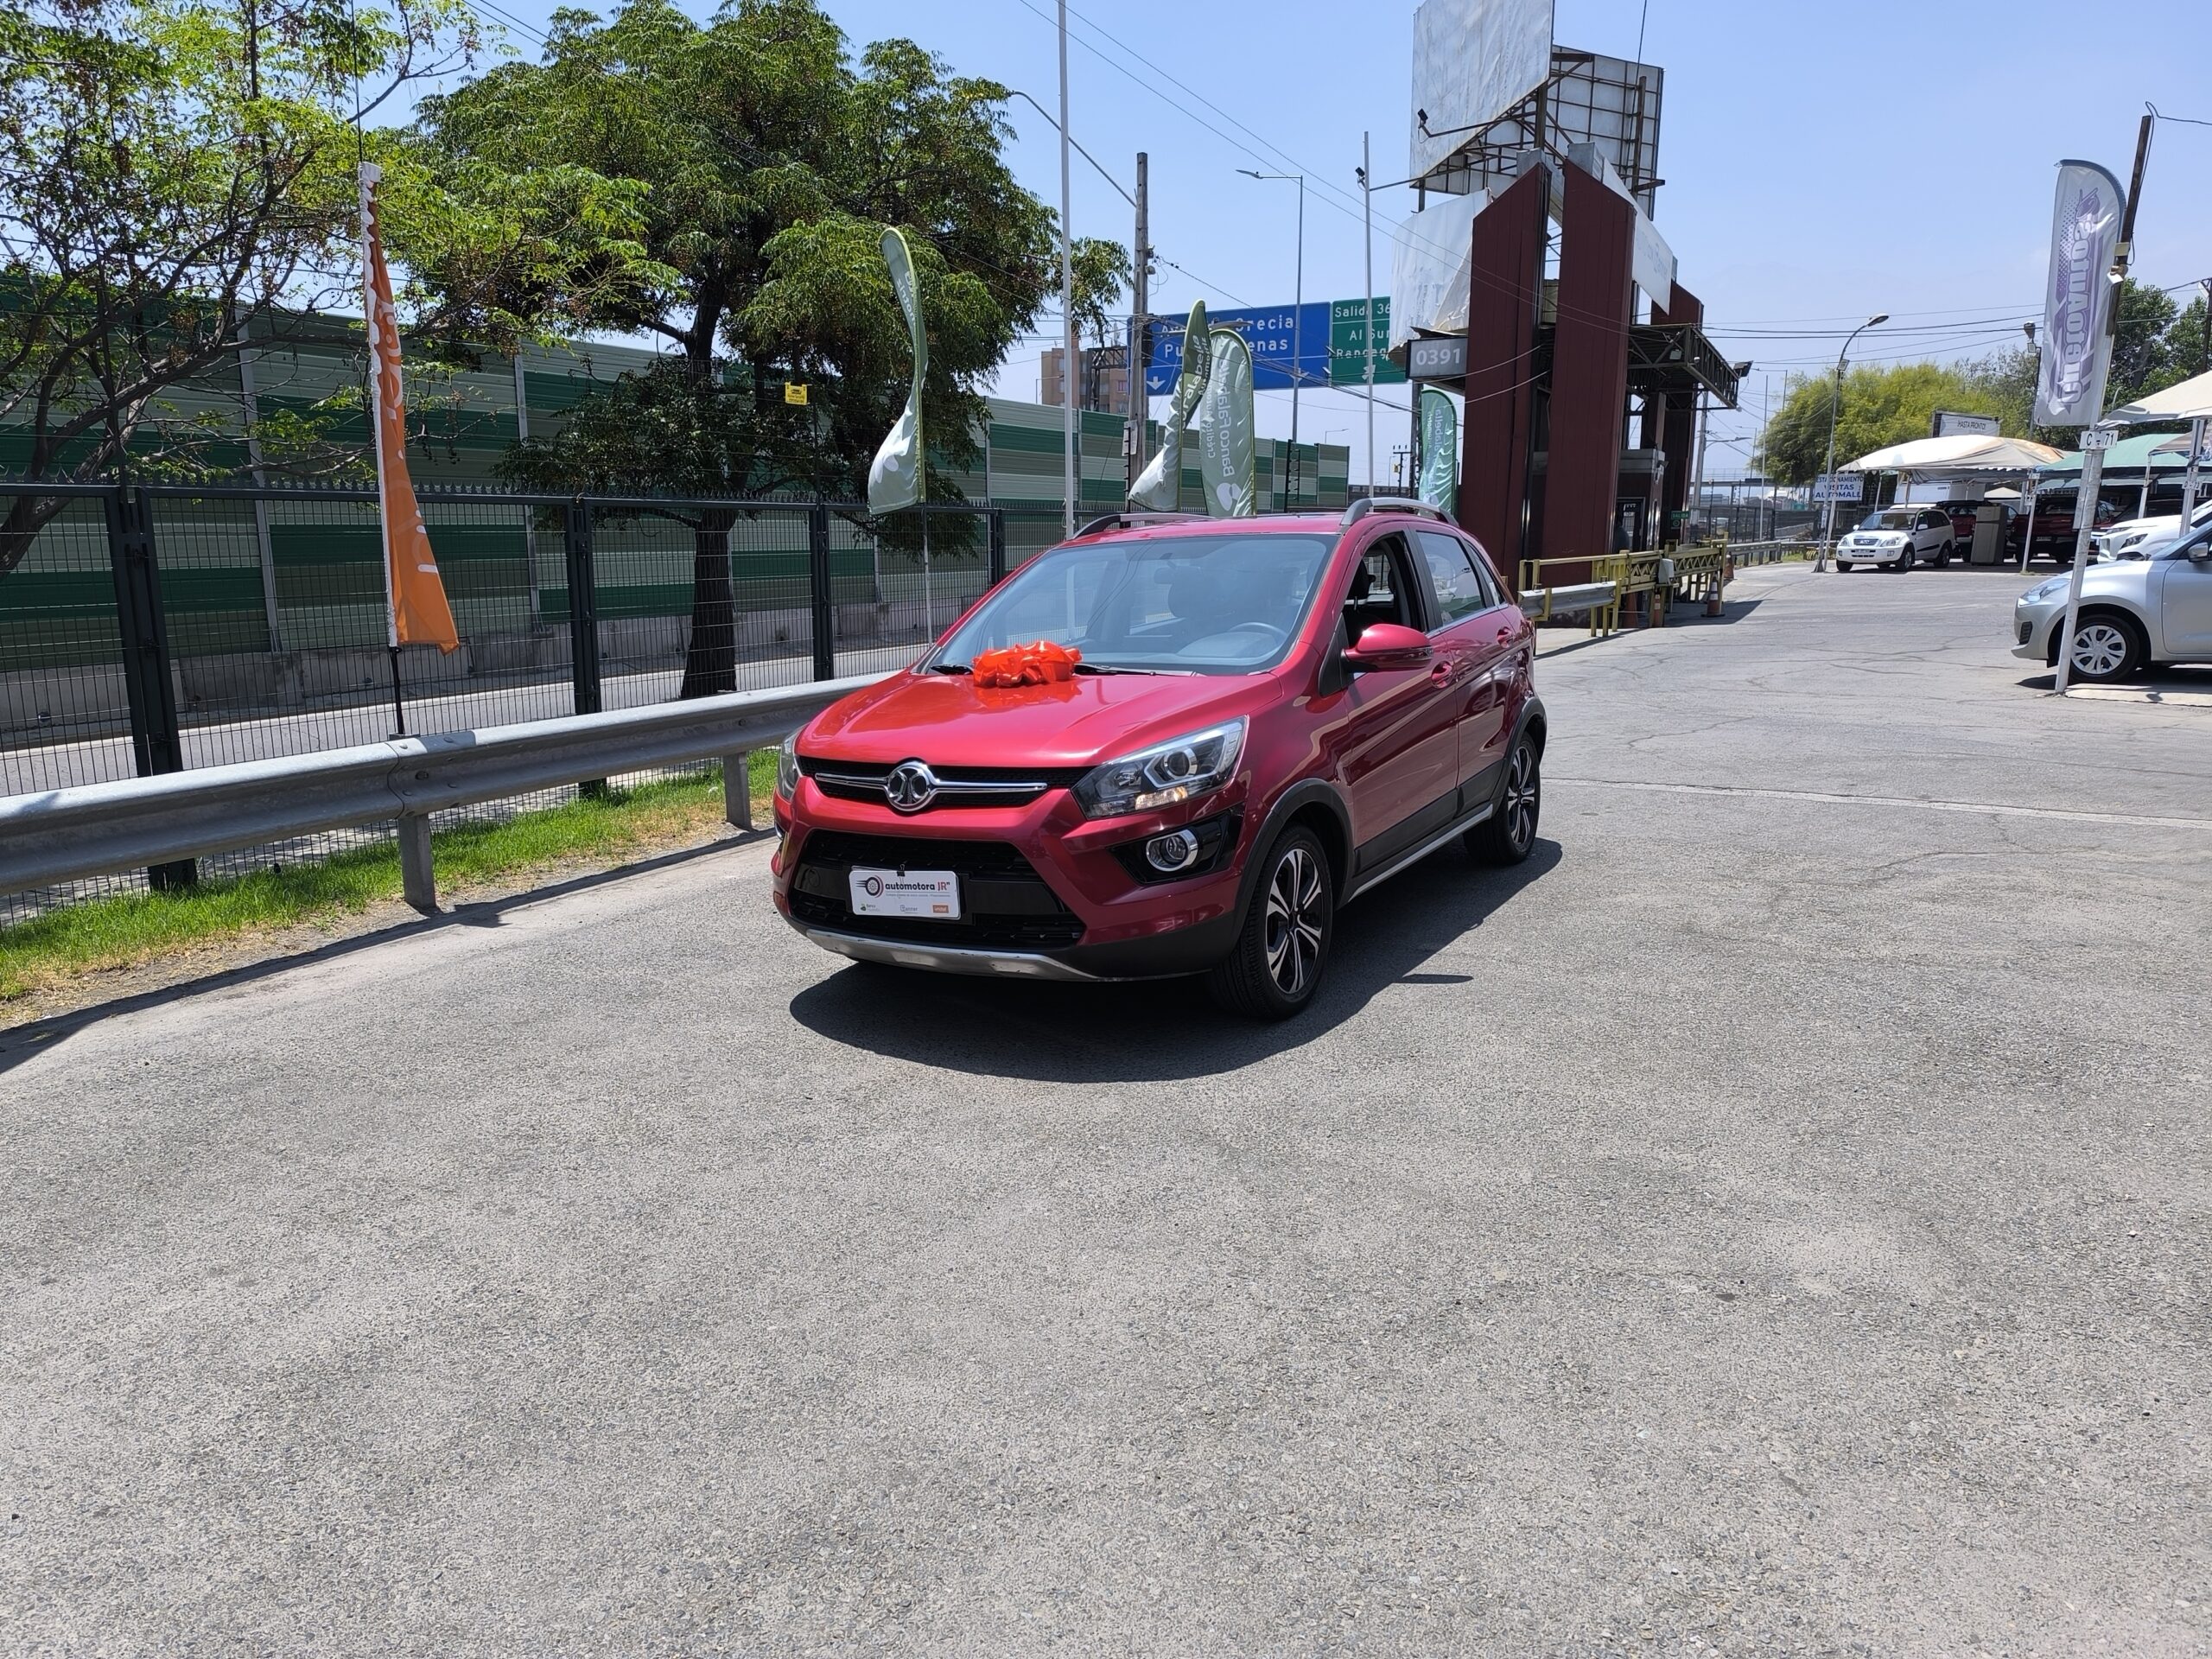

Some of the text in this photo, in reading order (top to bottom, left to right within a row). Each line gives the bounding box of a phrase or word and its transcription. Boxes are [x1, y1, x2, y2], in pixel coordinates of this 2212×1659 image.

[1335, 305, 1370, 318] Salid
[1349, 329, 1363, 341] Al
[1336, 347, 1387, 359] Rancag
[1415, 348, 1461, 365] 0391
[885, 881, 936, 891] automotora
